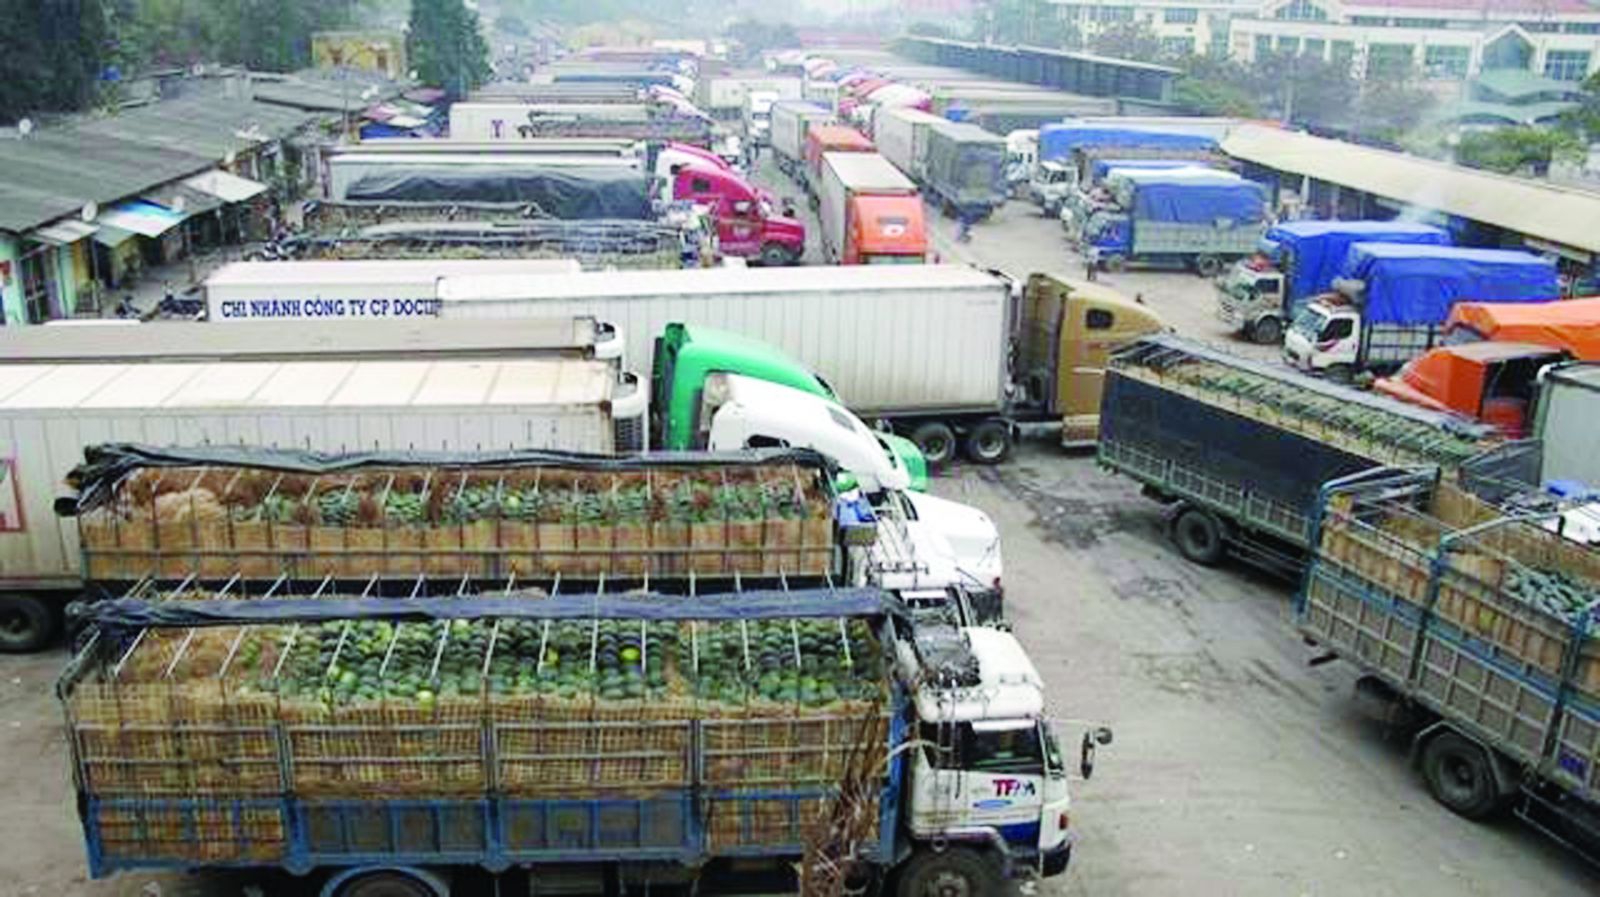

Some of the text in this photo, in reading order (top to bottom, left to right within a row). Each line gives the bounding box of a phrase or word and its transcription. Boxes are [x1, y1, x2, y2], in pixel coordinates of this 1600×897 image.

[221, 300, 247, 317] CHI
[304, 294, 345, 316] CÔNG
[348, 300, 367, 316] TY
[370, 299, 390, 316] CP
